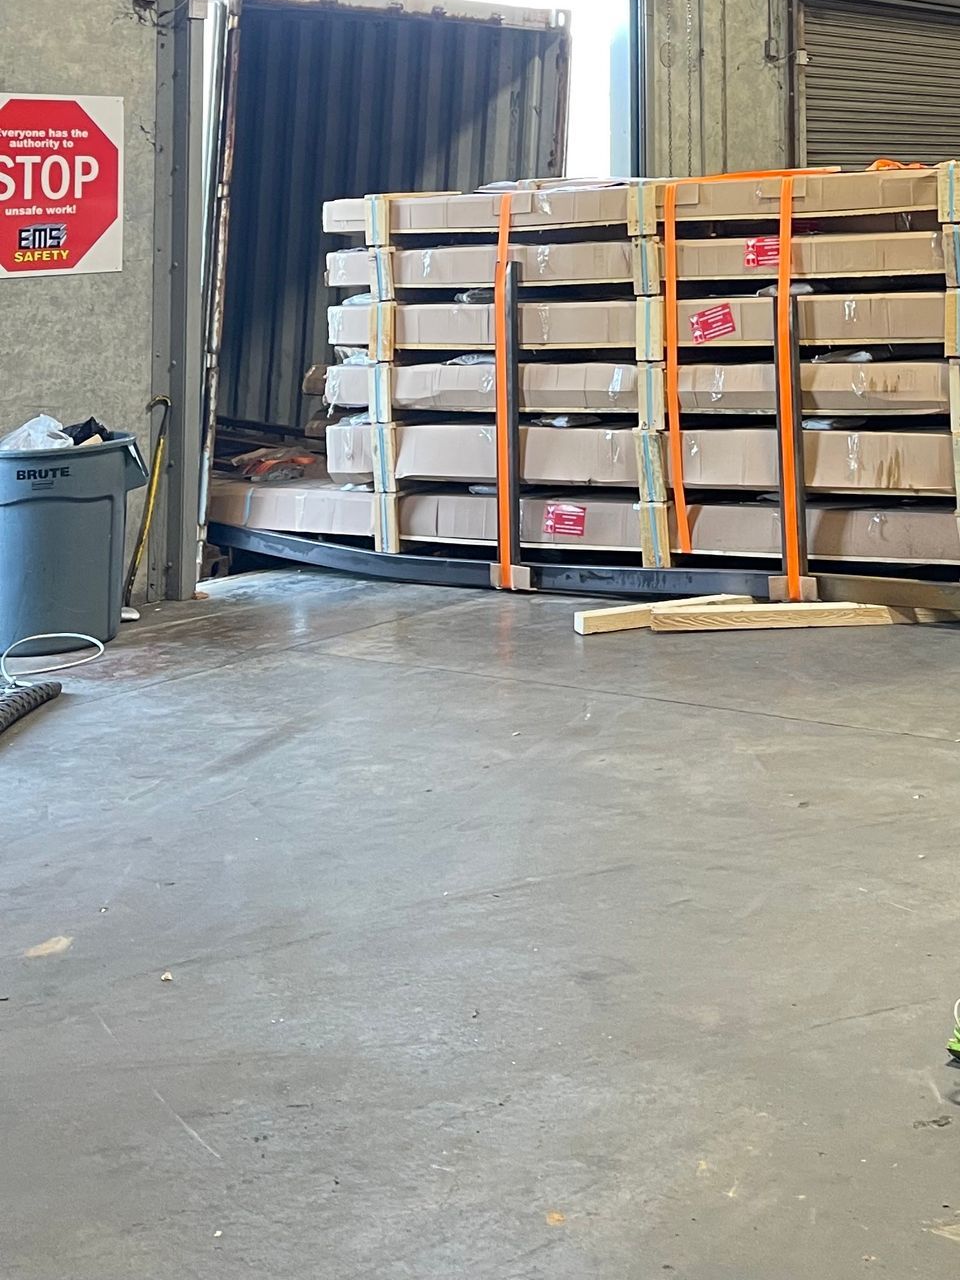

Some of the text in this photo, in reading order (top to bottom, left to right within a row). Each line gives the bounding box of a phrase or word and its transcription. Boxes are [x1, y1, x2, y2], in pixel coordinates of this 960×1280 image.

[0, 128, 89, 139] veryone has the
[9, 139, 74, 150] authority to
[0, 154, 99, 201] STOP
[5, 204, 76, 216] unsafe work!
[14, 250, 69, 263] SAFETY
[16, 466, 71, 480] BRUTE
